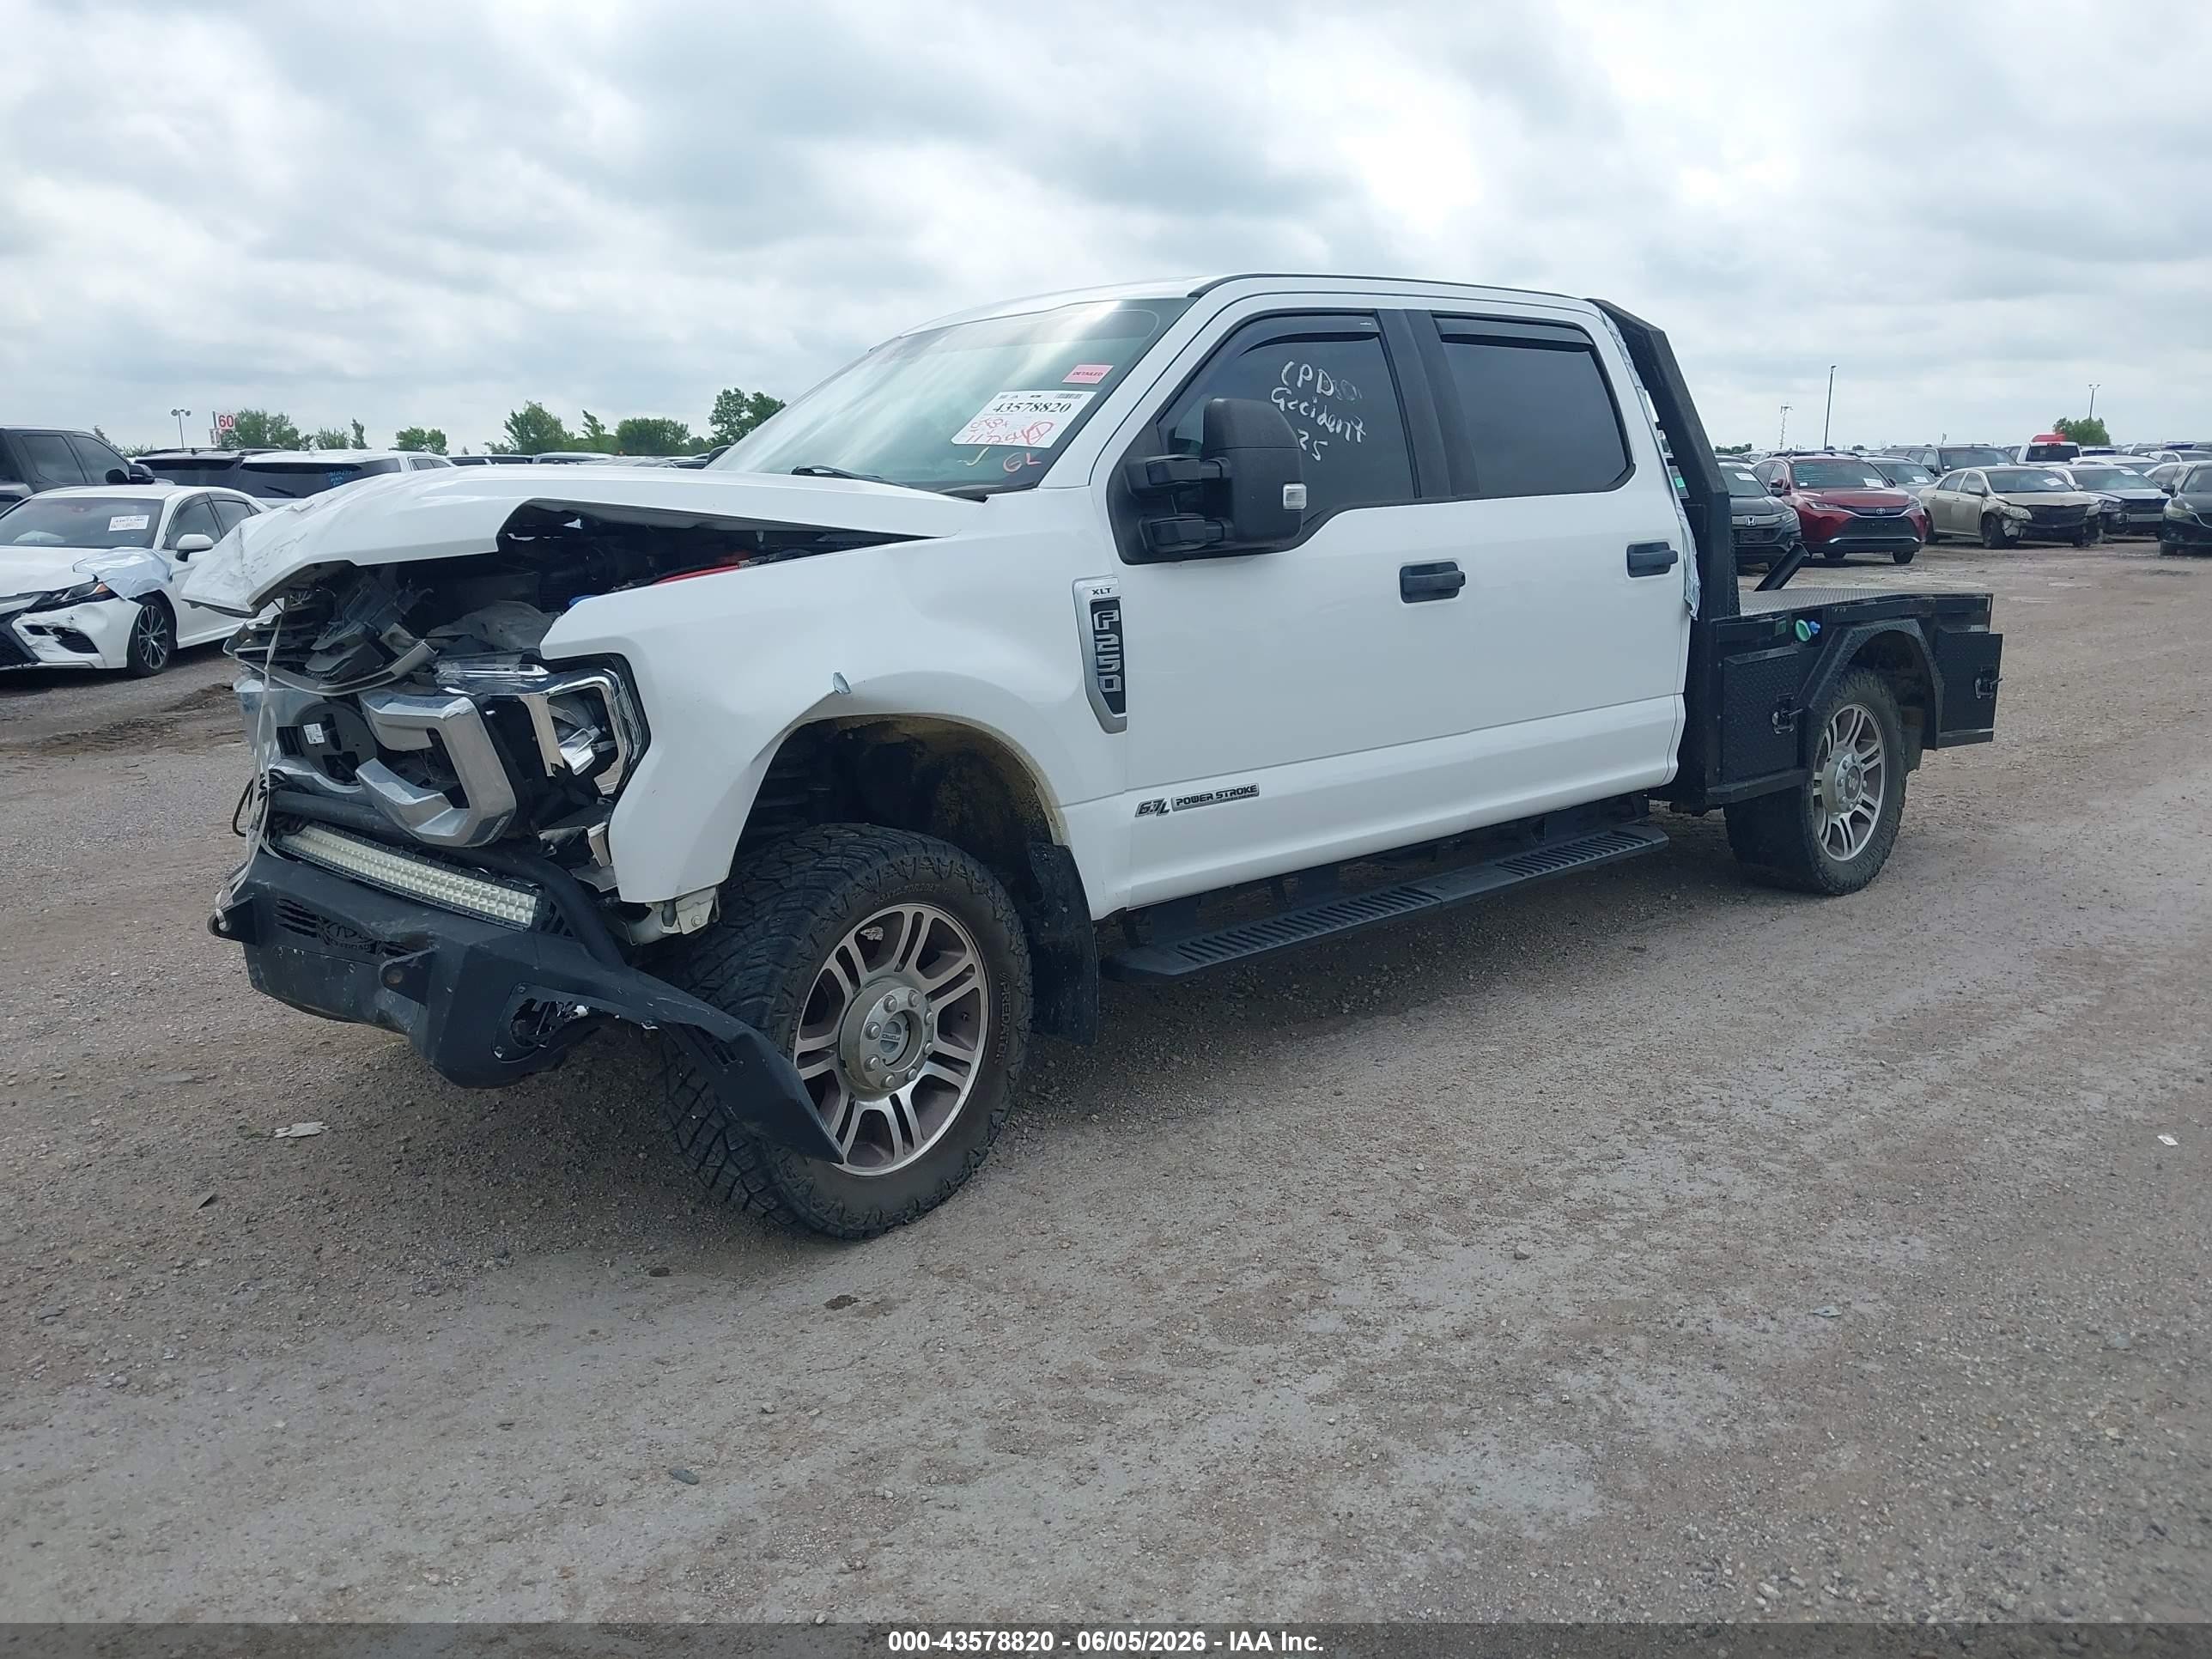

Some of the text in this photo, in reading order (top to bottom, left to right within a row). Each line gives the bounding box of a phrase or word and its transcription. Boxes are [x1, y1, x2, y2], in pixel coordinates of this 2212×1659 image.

[218, 415, 234, 428] 60
[993, 402, 1073, 413] 43578820
[1093, 609, 1122, 694] F250
[1136, 799, 1170, 817] 6.7L
[1175, 793, 1214, 806] POWER
[1216, 784, 1258, 799] STROKE
[994, 981, 1011, 1065] PREDATOR
